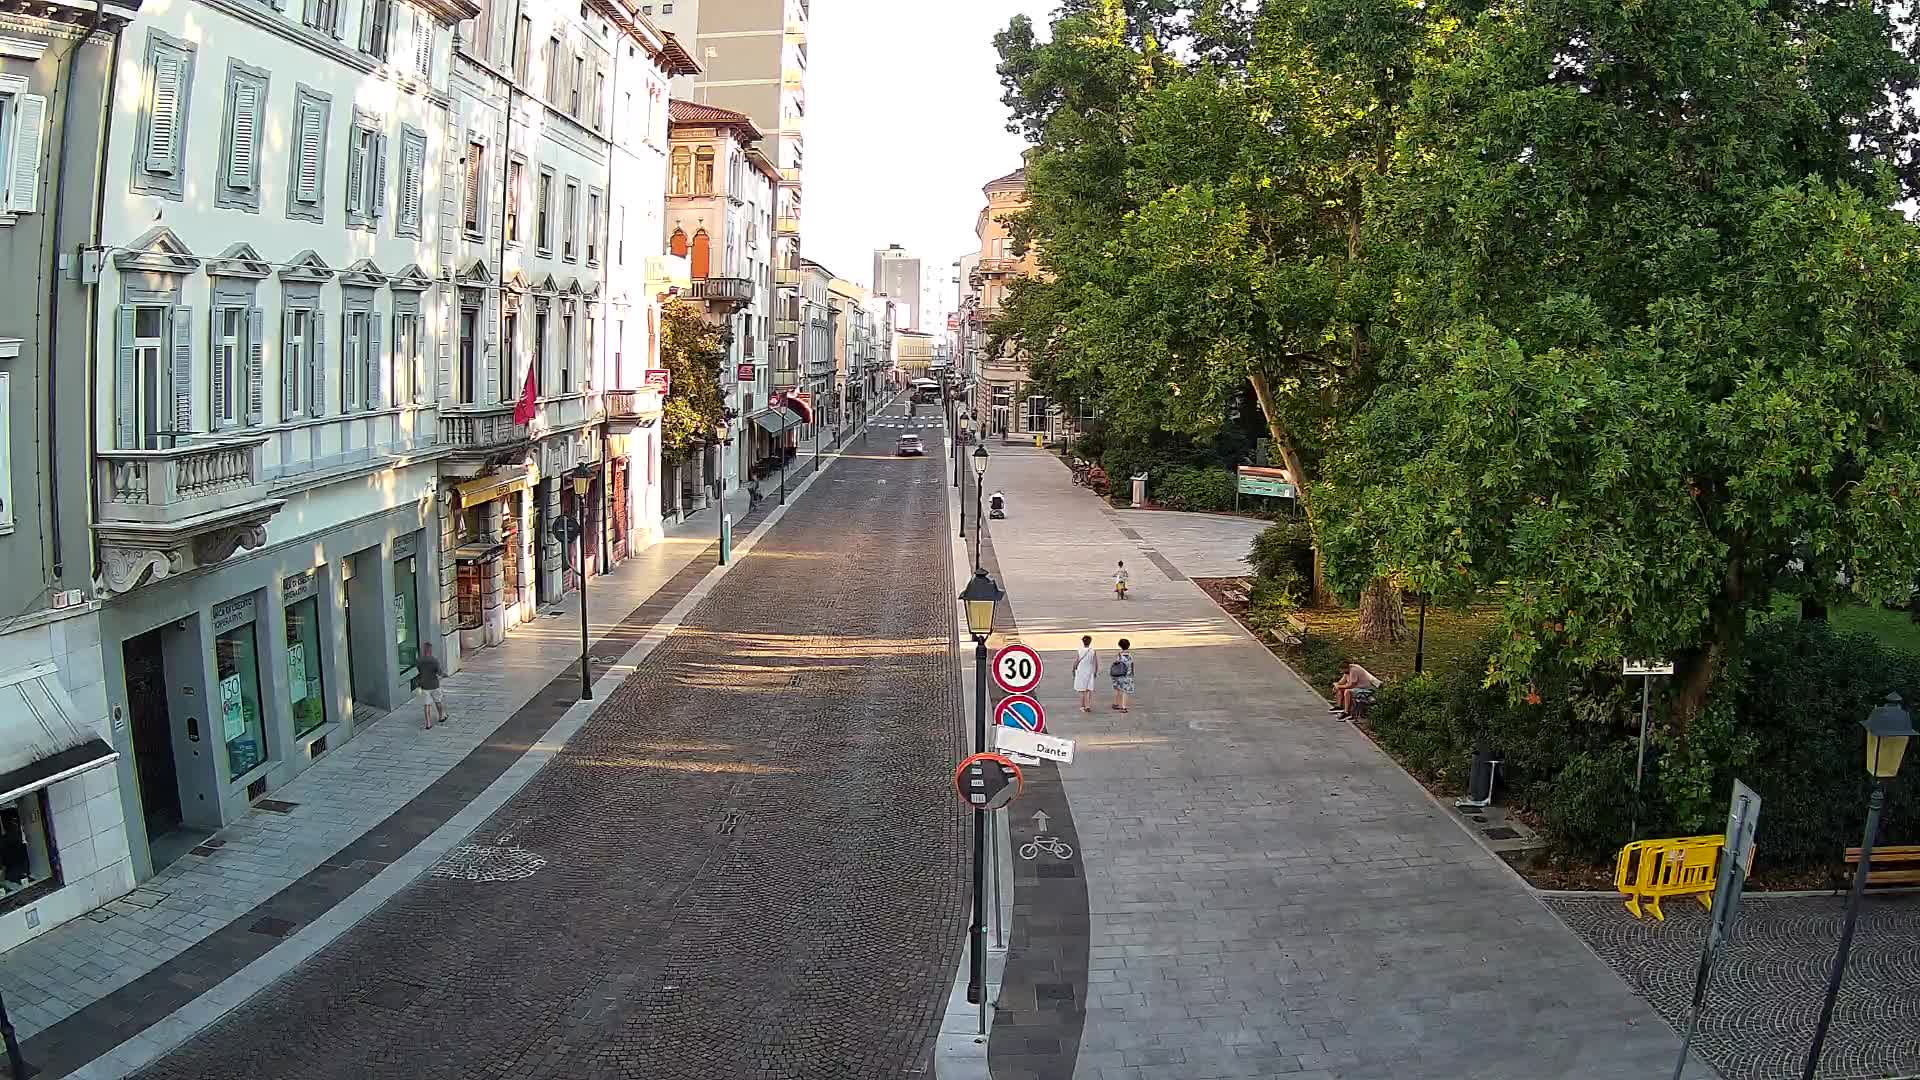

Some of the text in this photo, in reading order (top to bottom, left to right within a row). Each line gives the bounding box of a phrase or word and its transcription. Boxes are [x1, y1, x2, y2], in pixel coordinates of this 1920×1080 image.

[1005, 658, 1032, 679] 30
[221, 679, 240, 701] 130
[1036, 743, 1067, 757] Dante
